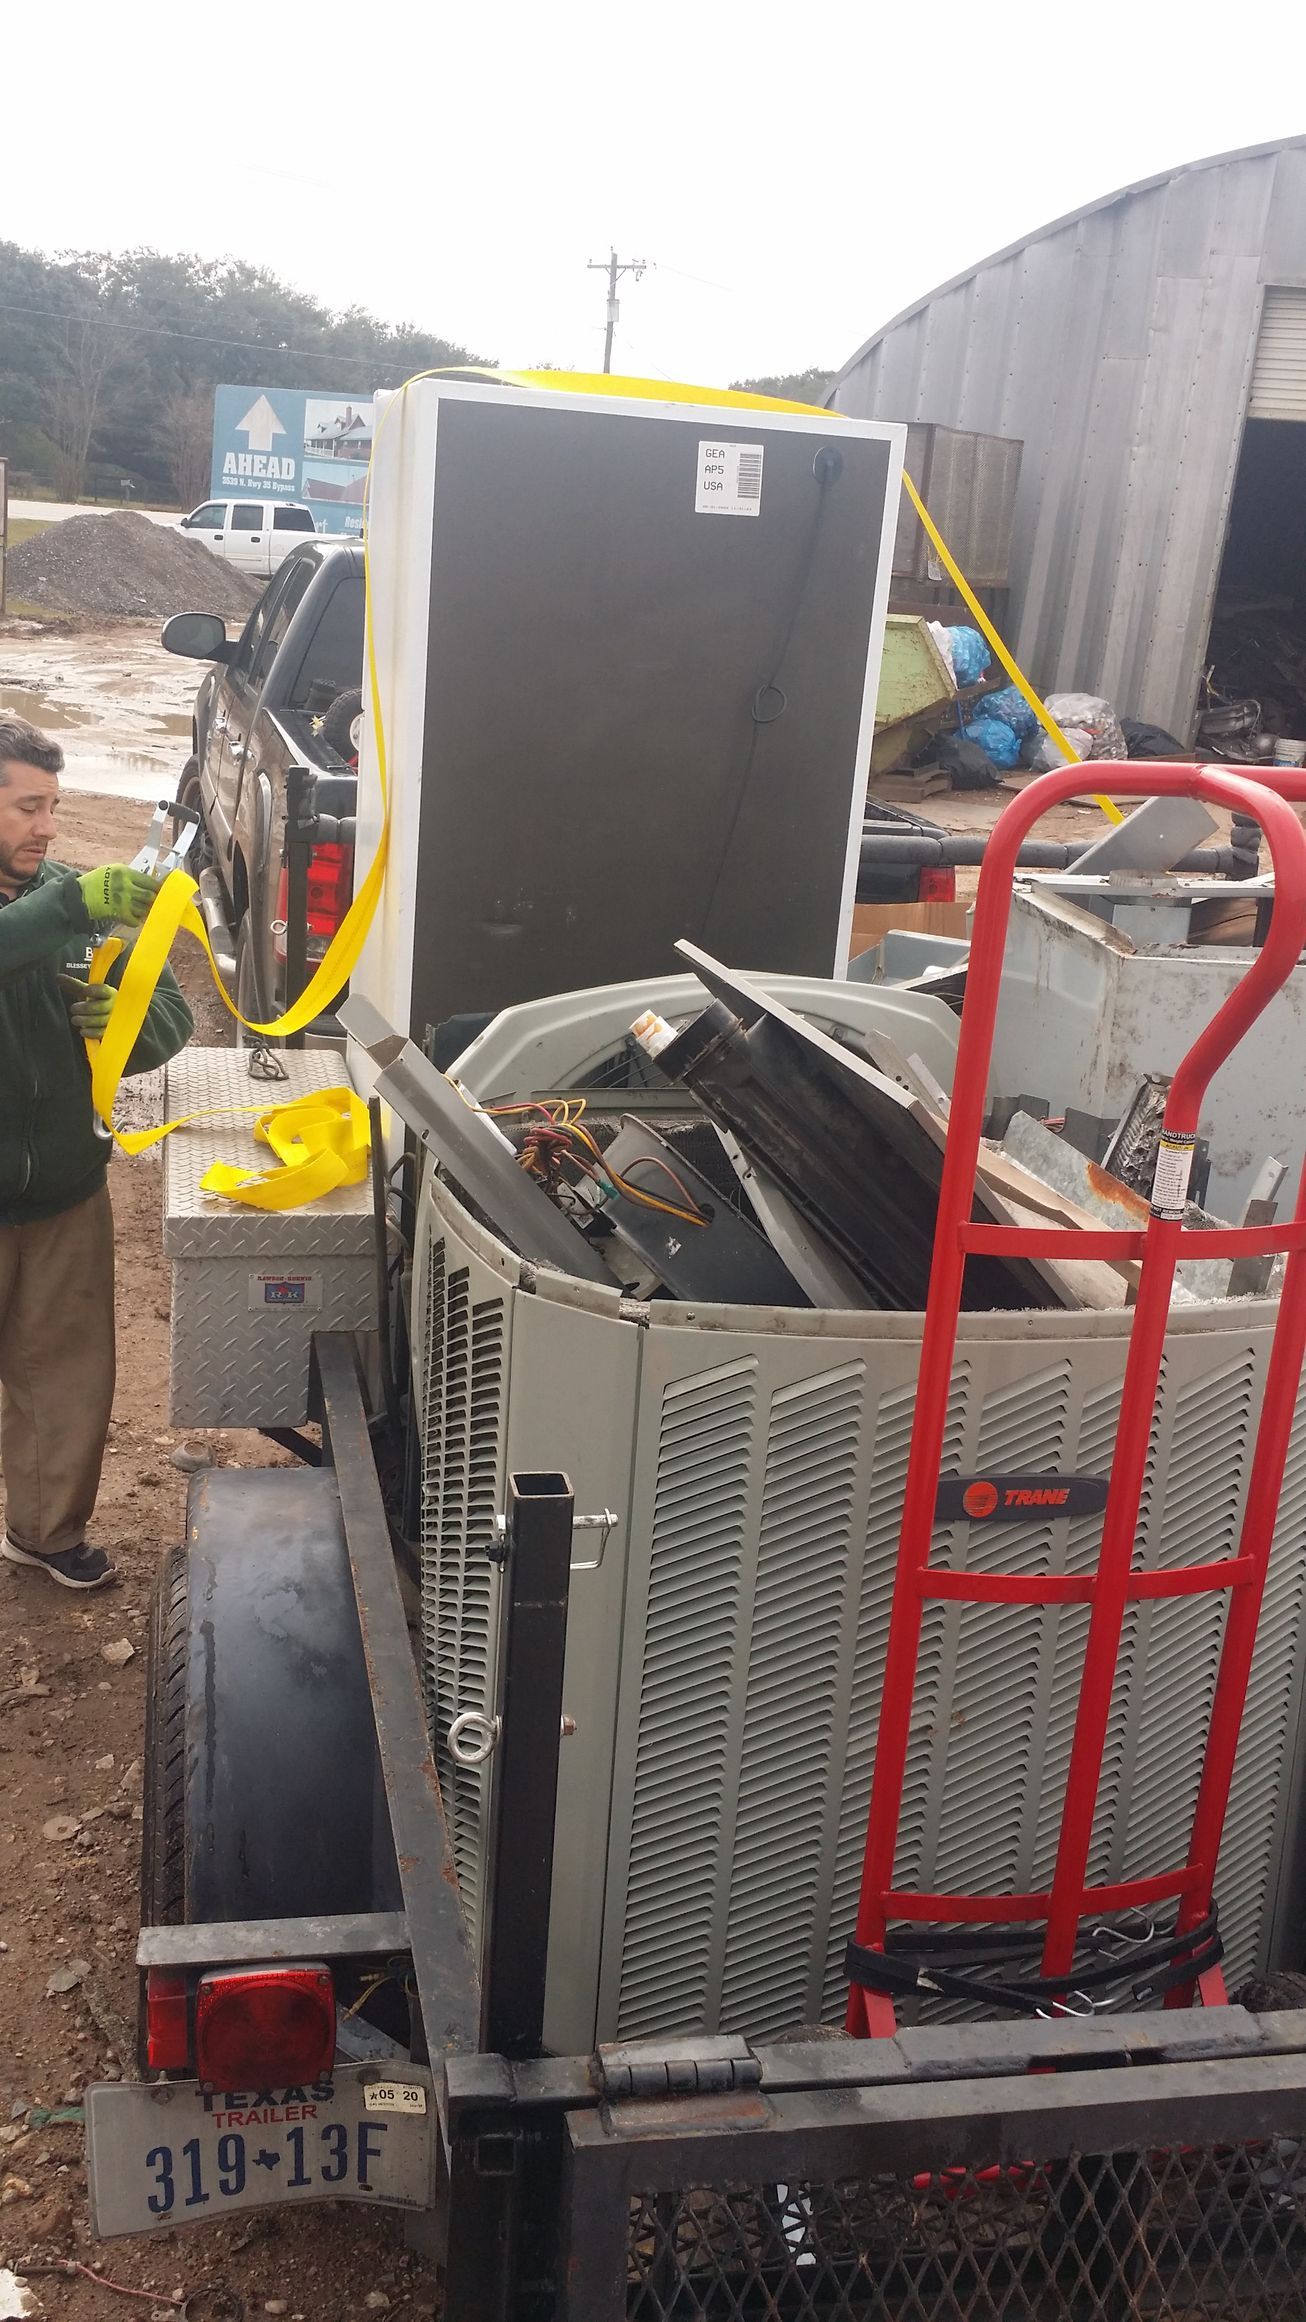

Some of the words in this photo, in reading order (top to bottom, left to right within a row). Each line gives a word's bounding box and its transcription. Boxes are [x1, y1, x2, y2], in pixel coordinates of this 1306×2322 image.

[705, 449, 725, 459] GEA
[222, 452, 296, 480] AHEAD
[247, 479, 262, 490] Hwy
[272, 481, 295, 492] Bypass
[703, 481, 724, 491] USA
[103, 866, 111, 905] HARDY
[1004, 1488, 1071, 1506] TRANE
[195, 2077, 335, 2112] TEXAS
[379, 2089, 395, 2100] 05
[403, 2090, 418, 2101] 20
[212, 2104, 318, 2129] TRAILER
